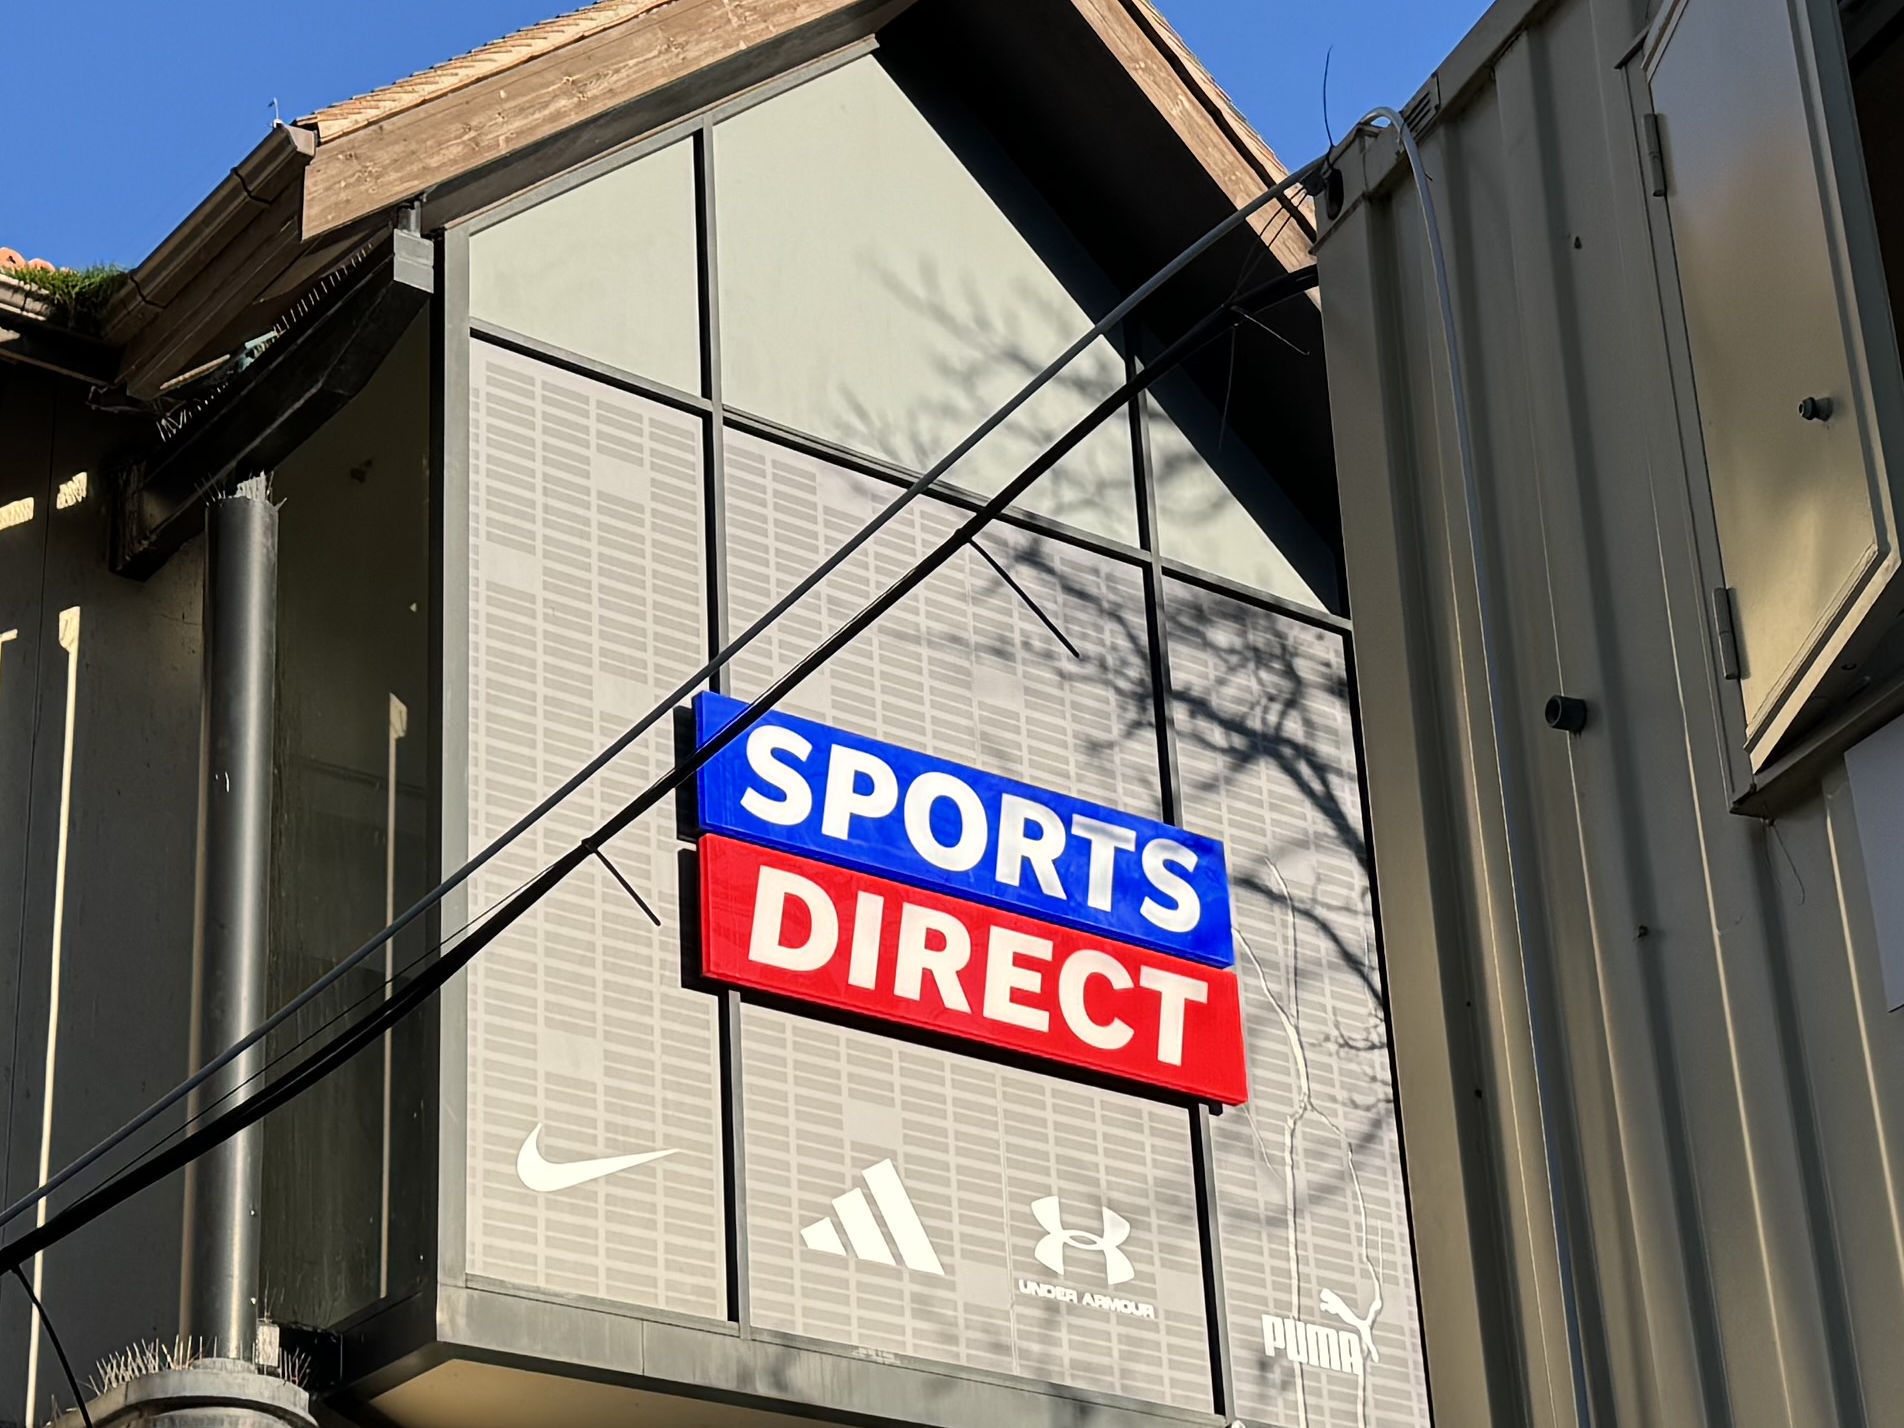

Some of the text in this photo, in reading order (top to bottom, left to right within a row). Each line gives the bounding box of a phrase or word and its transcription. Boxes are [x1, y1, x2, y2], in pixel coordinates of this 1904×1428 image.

[739, 724, 1201, 933] SPORTS
[747, 864, 1208, 1067] DIRECT
[1018, 1278, 1156, 1319] UNDER ARMOUR
[1261, 1313, 1365, 1374] PUMA
